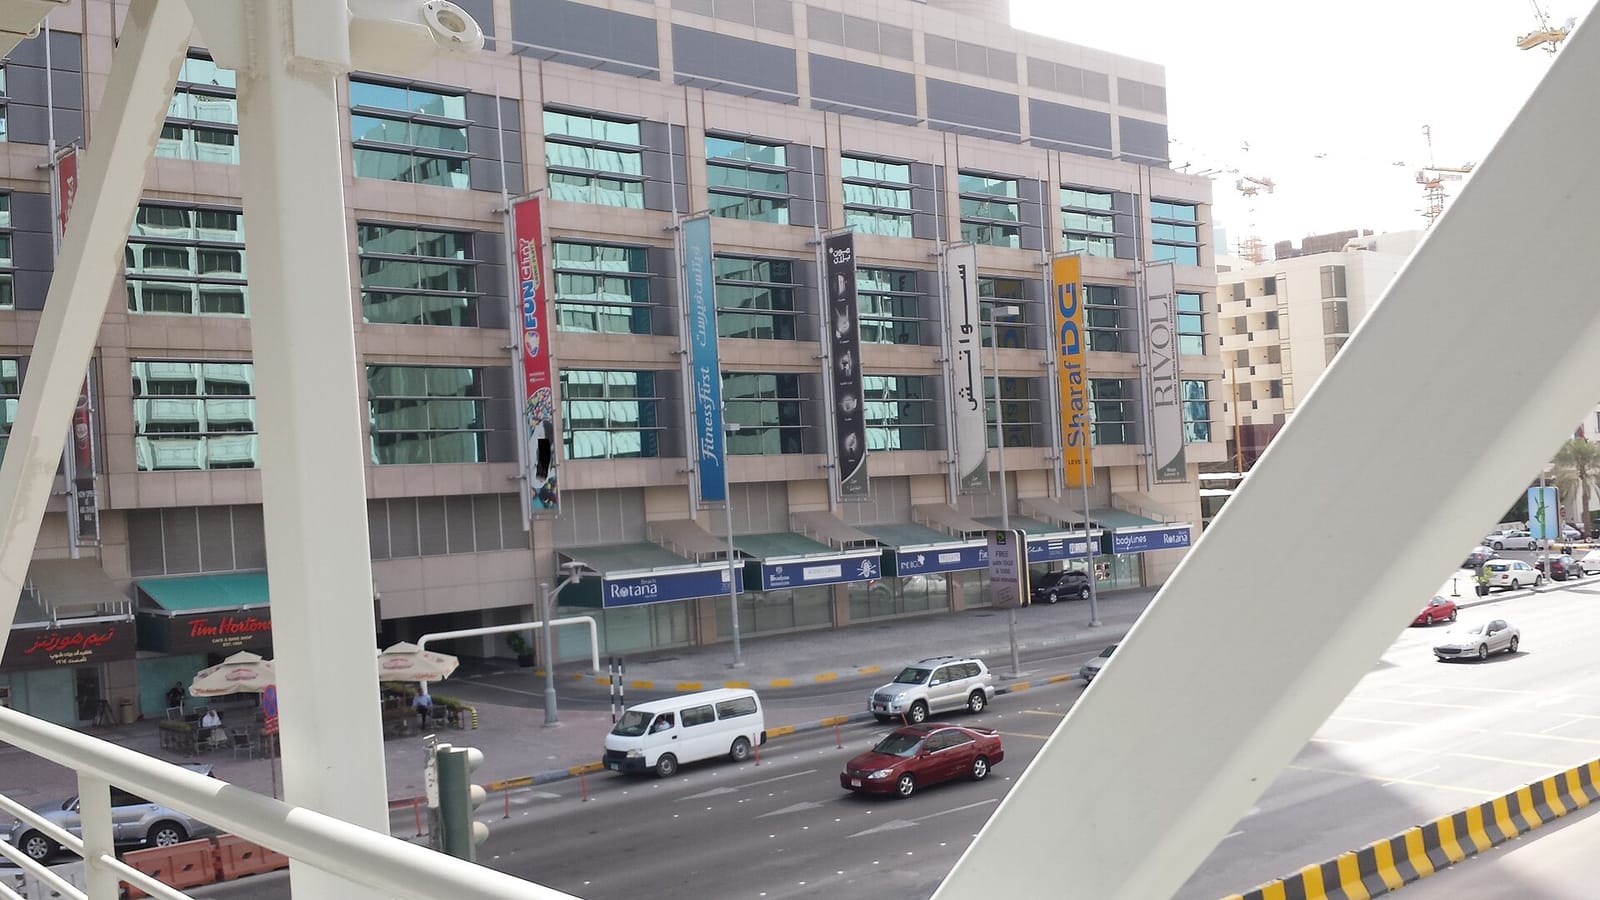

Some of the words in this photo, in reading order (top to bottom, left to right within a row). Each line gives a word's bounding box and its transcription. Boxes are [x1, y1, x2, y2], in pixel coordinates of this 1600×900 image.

[1149, 293, 1174, 408] RIVOLI
[1064, 360, 1086, 447] Sharaf
[1163, 533, 1188, 544] Rotana
[610, 583, 658, 598] Rotana
[188, 618, 217, 637] Tim
